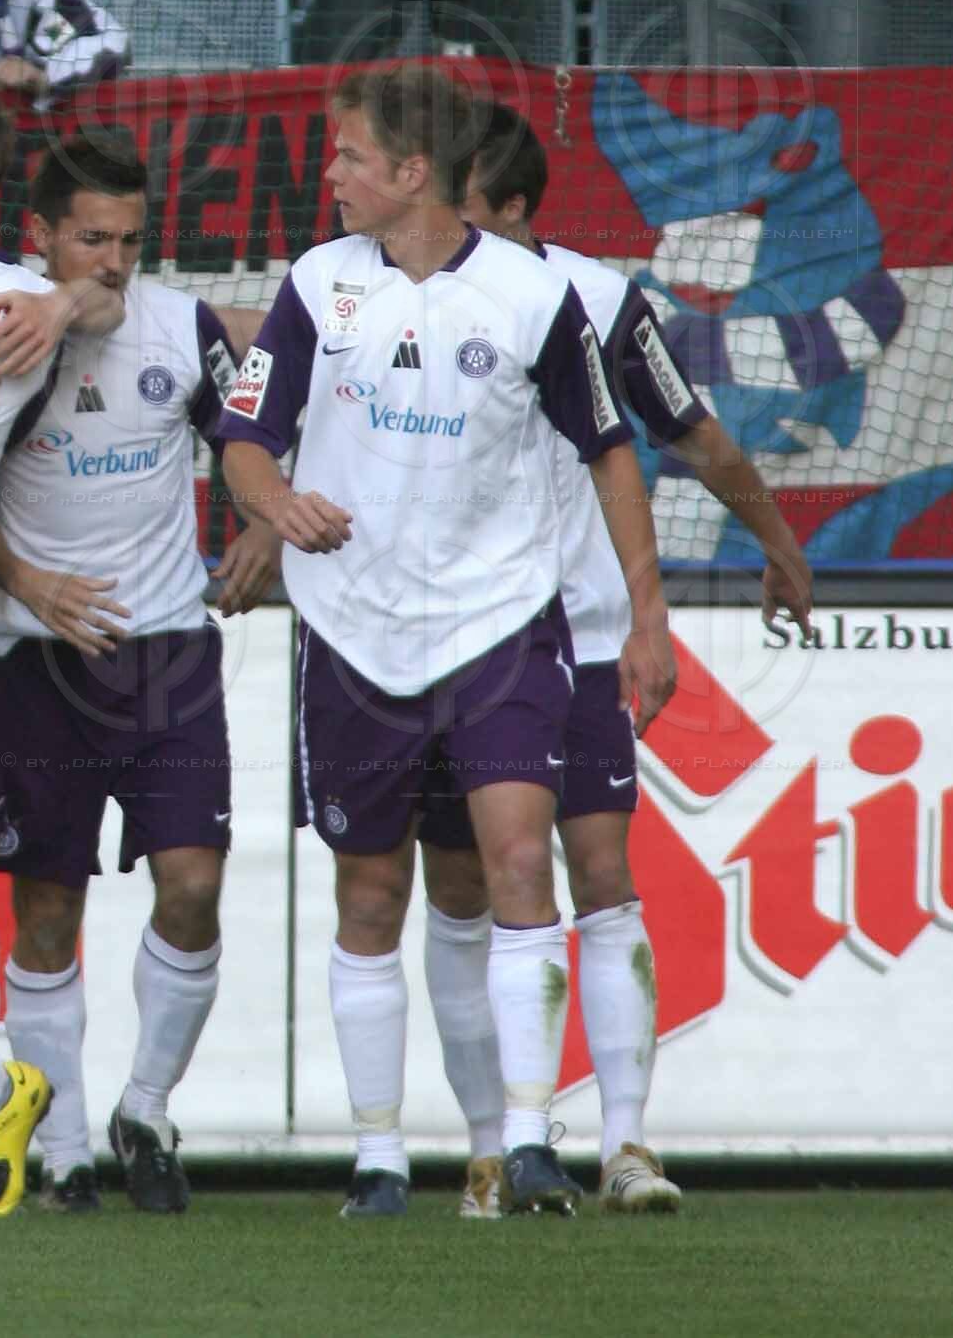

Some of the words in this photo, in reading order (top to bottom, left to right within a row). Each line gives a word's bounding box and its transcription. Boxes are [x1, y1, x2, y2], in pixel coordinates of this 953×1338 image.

[87, 111, 330, 274] IEN
[646, 344, 685, 414] MAGNA
[368, 403, 465, 437] Verbund
[65, 439, 159, 477] Verbund
